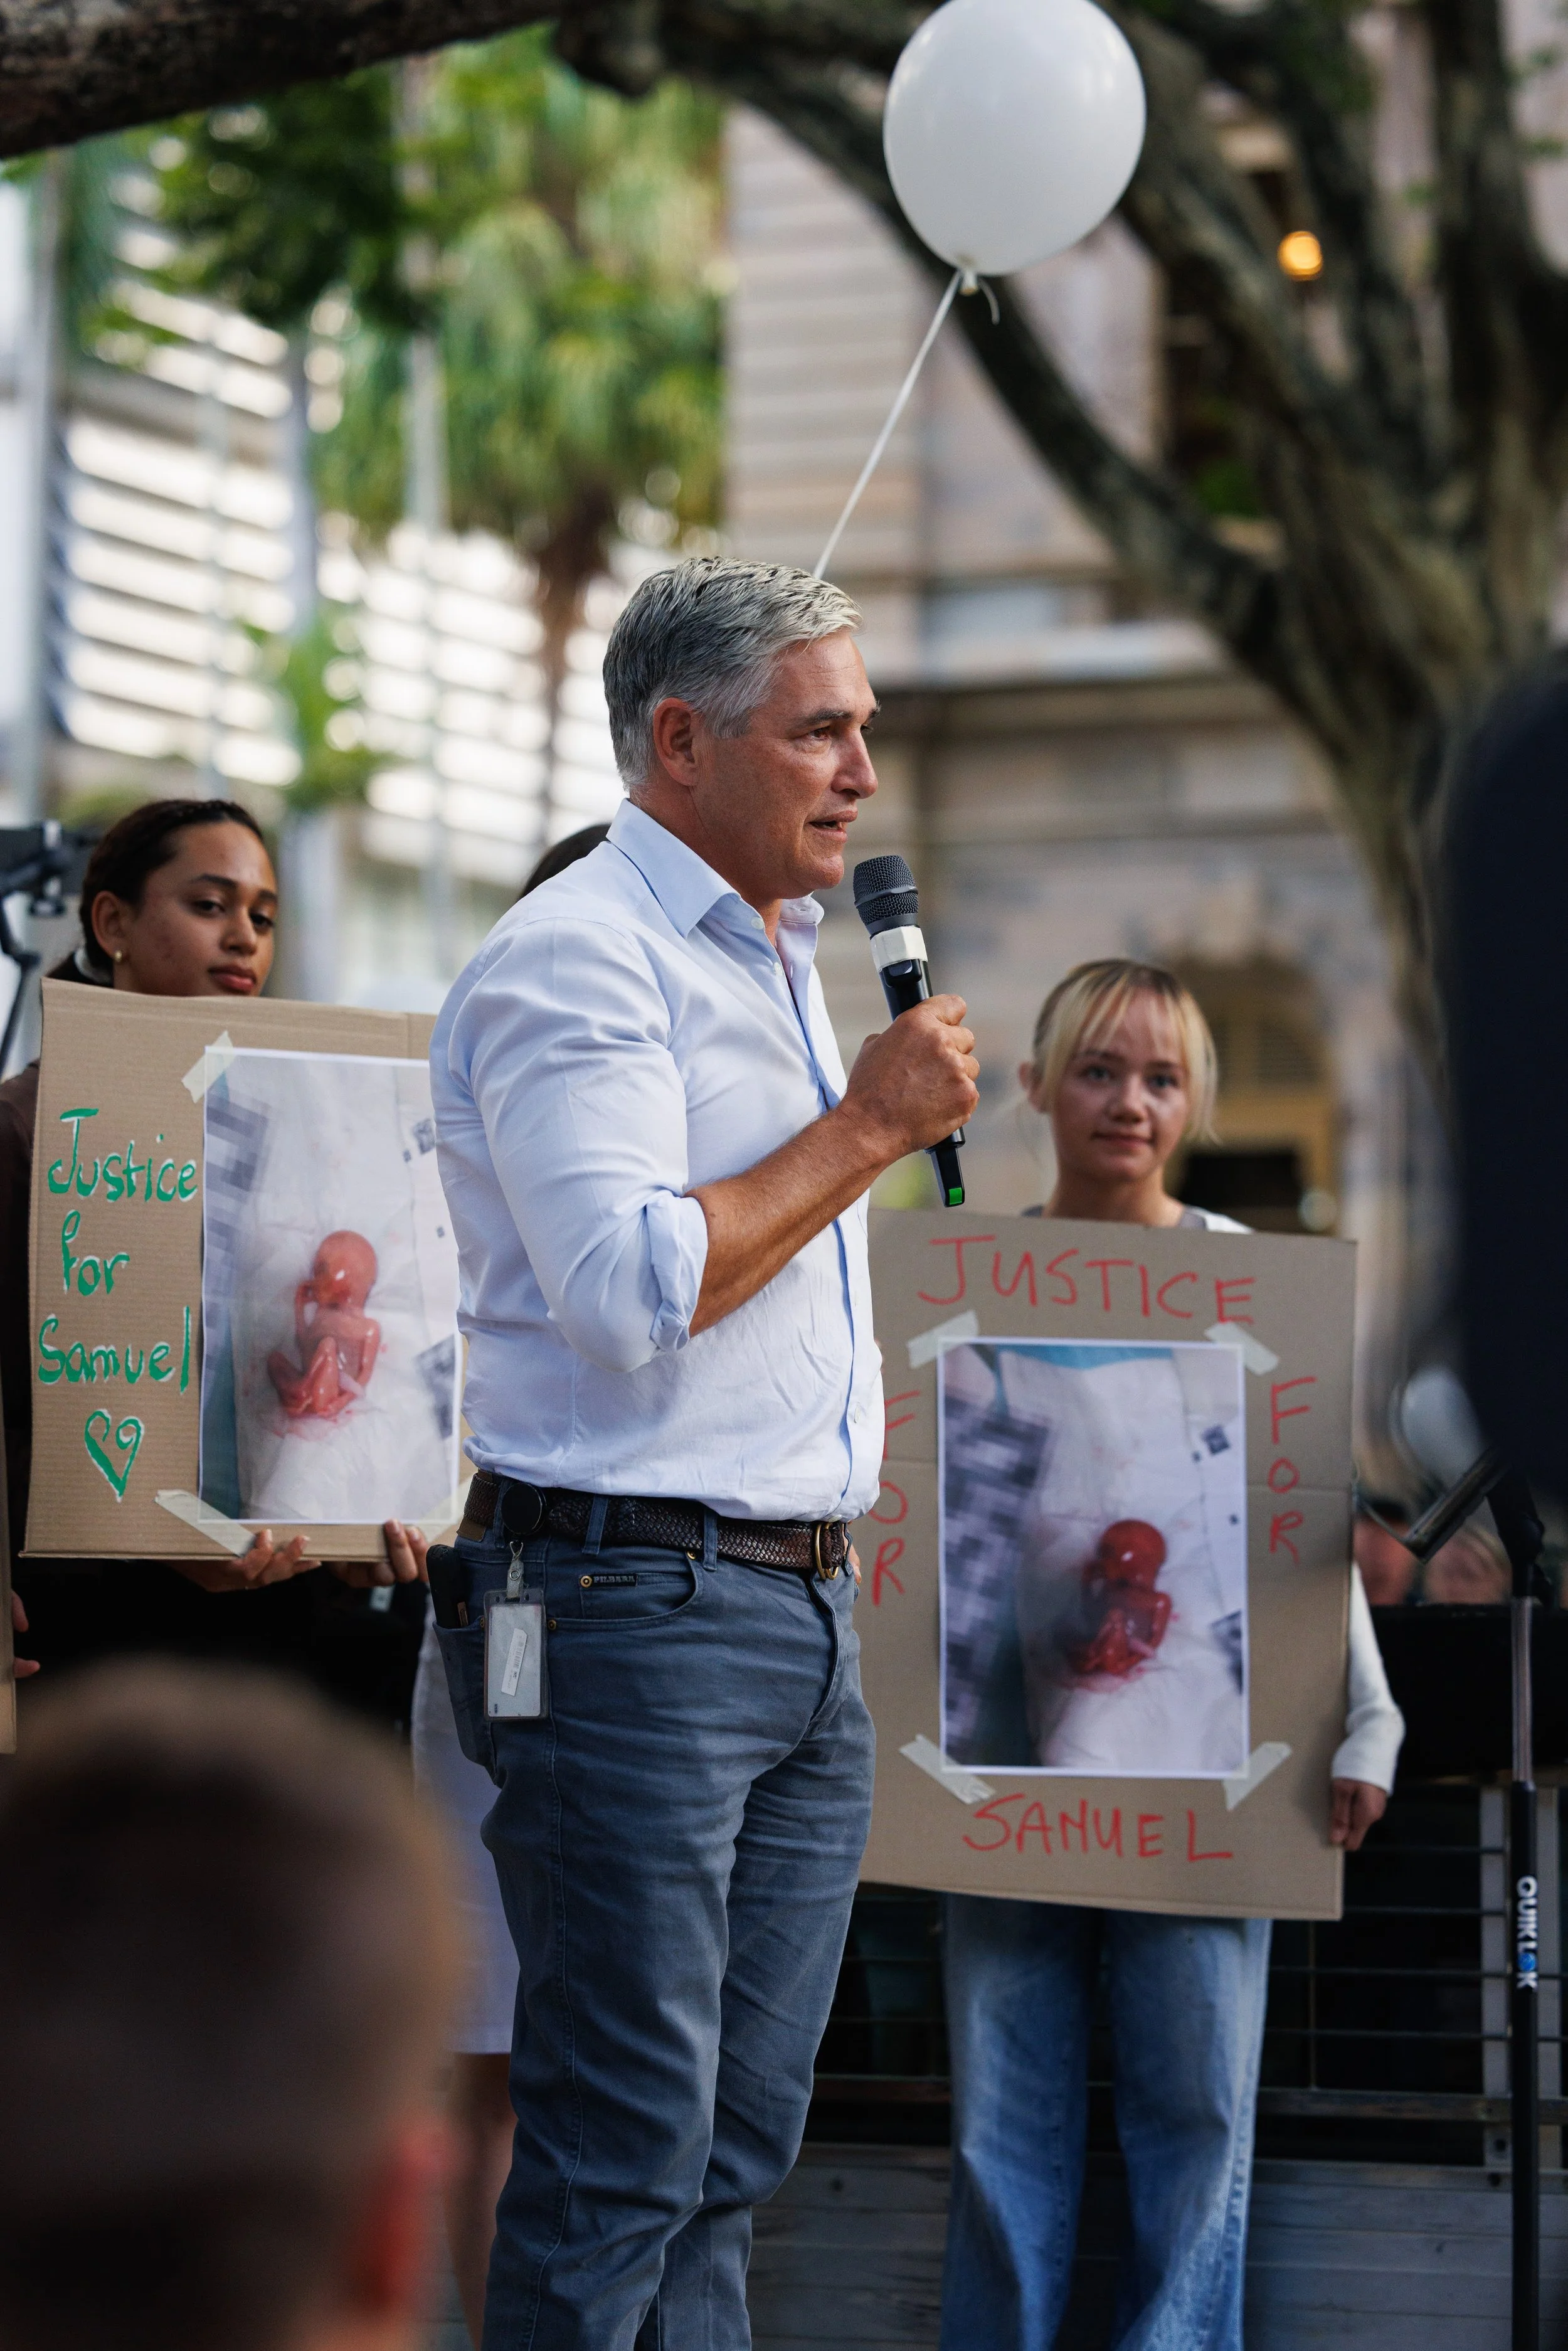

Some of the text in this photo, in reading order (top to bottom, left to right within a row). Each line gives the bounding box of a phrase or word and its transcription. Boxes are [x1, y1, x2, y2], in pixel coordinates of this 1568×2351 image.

[47, 1108, 198, 1202] Justice
[61, 1210, 130, 1297] for
[918, 1234, 1255, 1324] JUSTICE
[38, 1306, 191, 1394] Samuel
[868, 1390, 921, 1606] FOR
[1268, 1376, 1317, 1564] FOR
[961, 1792, 1234, 1863] SAMUEL
